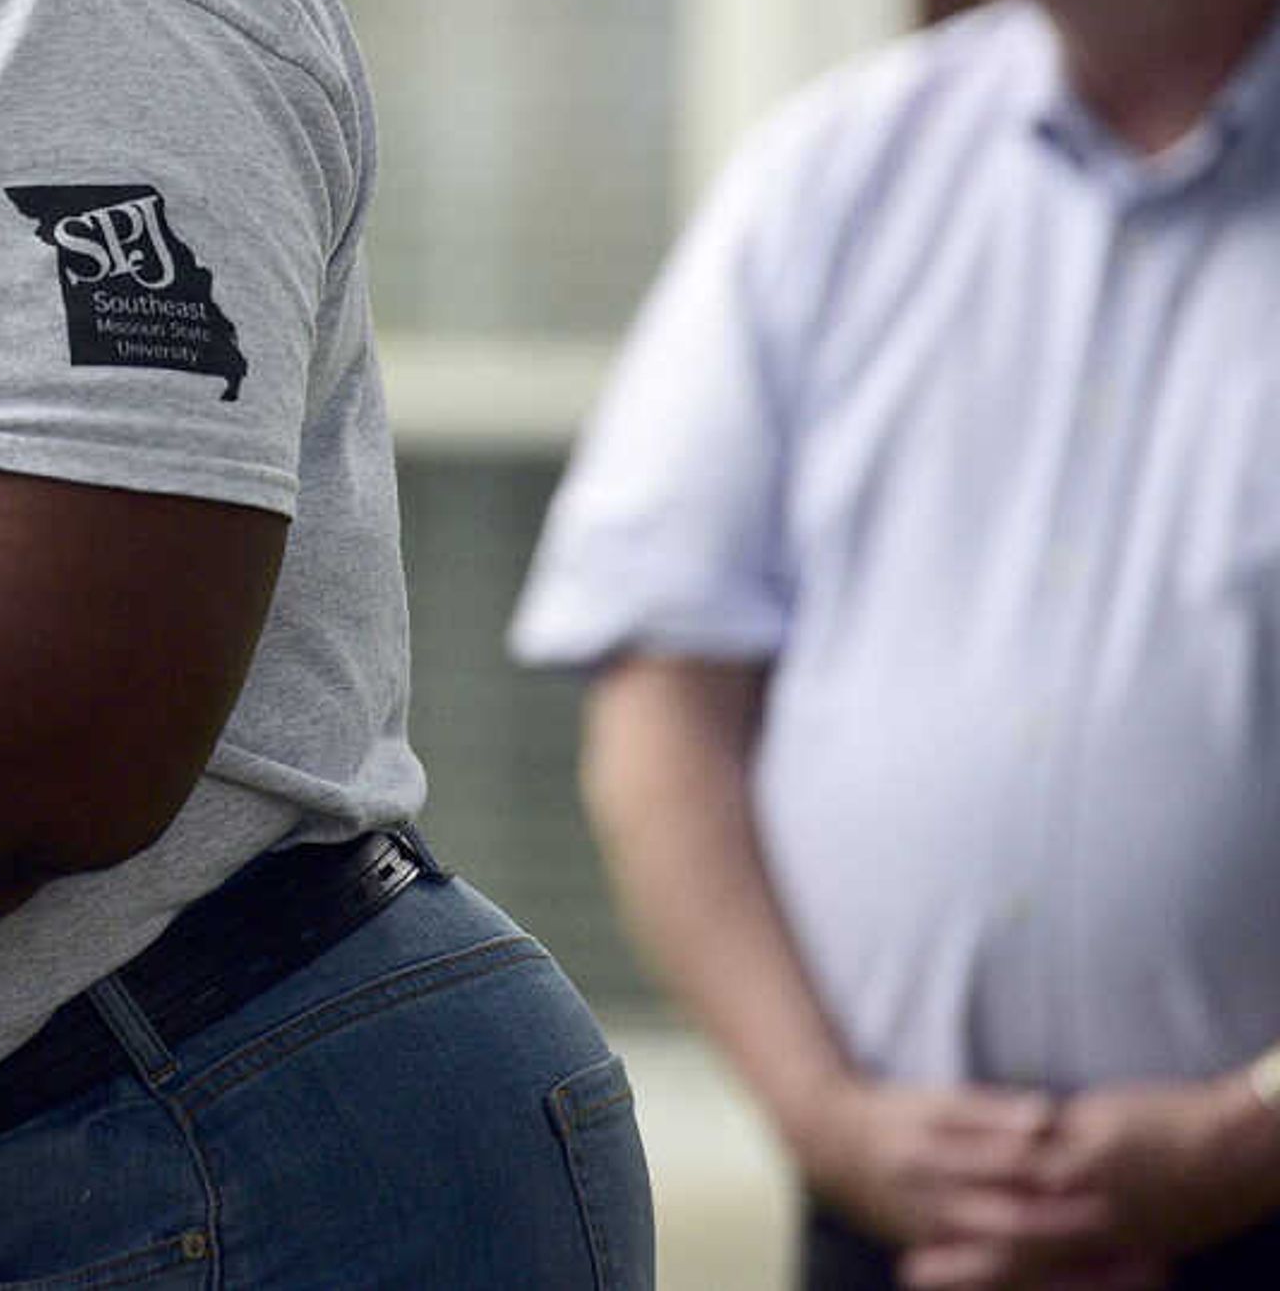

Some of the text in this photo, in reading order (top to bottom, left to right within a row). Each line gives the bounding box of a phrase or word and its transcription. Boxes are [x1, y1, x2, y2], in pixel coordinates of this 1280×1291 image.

[53, 194, 175, 289] SPJ
[92, 290, 207, 321] Southeast
[117, 340, 199, 363] University
